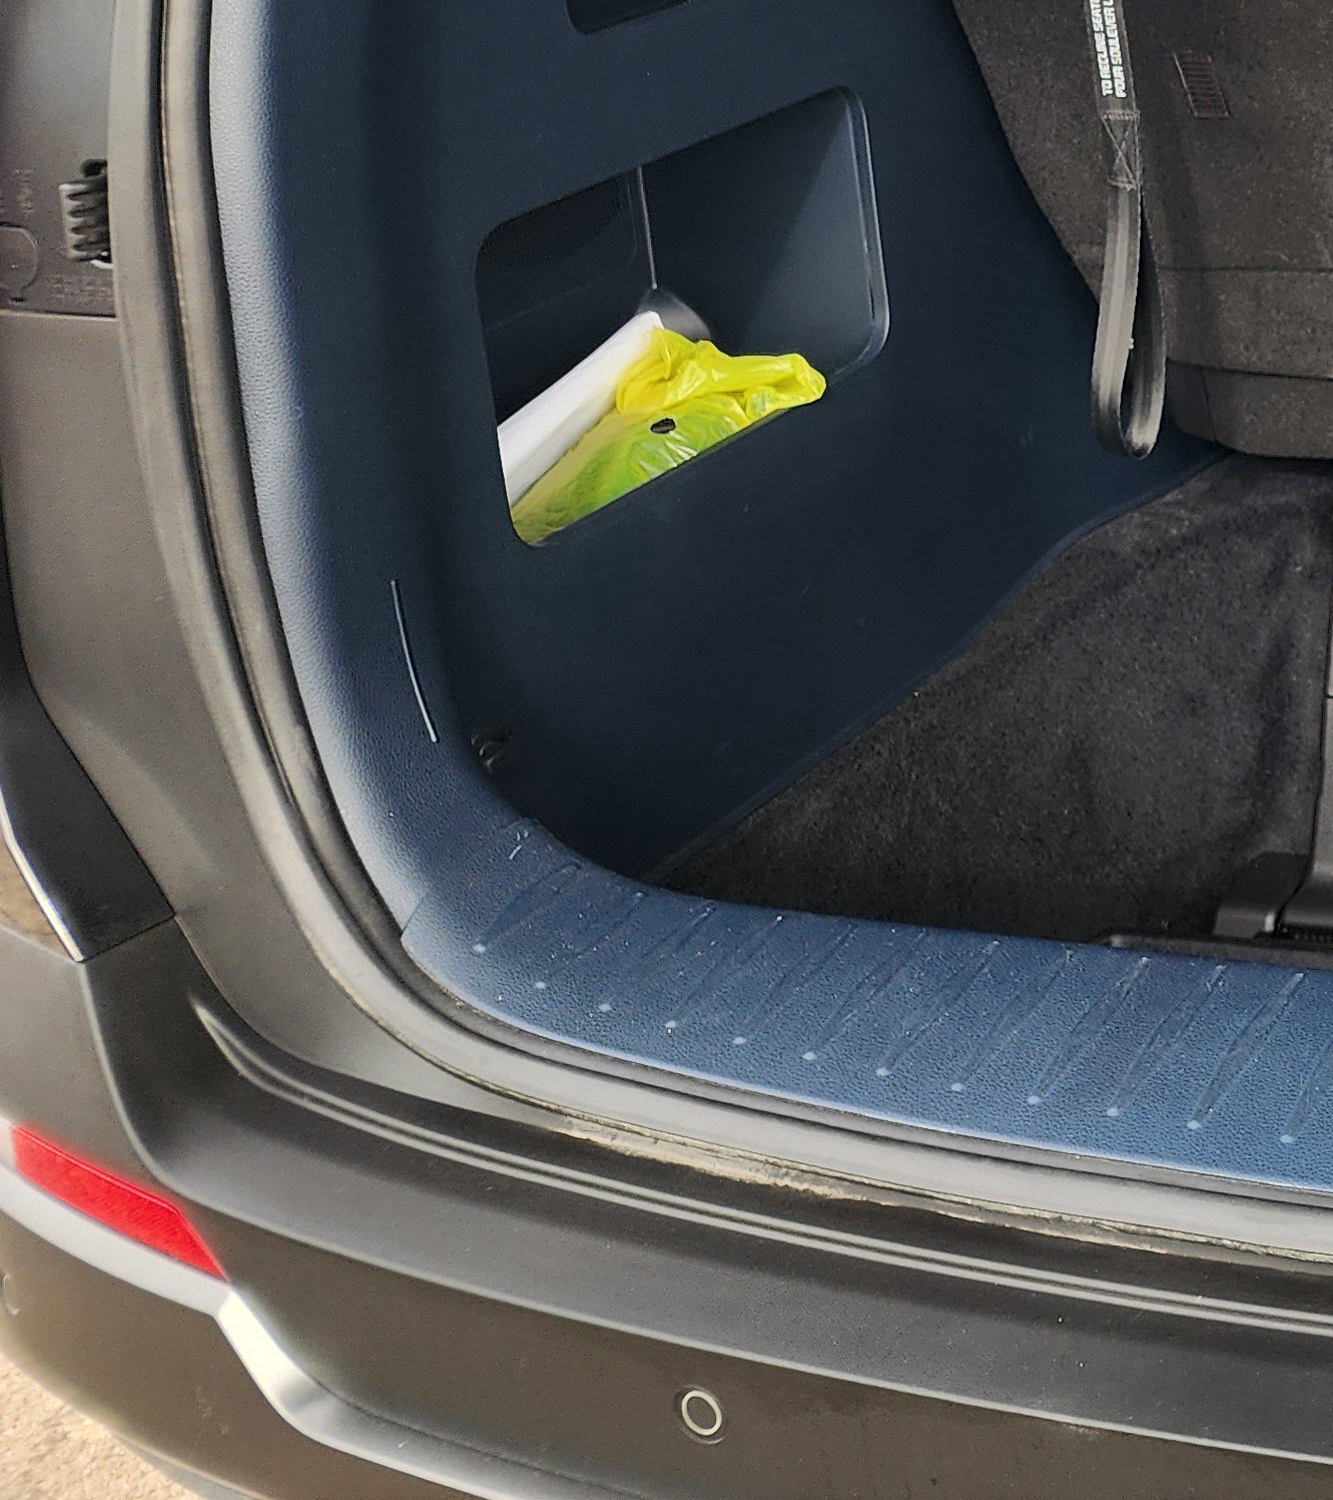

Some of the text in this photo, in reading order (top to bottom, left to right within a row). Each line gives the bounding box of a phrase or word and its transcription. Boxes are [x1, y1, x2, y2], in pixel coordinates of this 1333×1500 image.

[1094, 32, 1111, 78] RECLINE
[1103, 7, 1122, 65] SOULEVER
[1101, 80, 1113, 96] TO
[1112, 66, 1127, 97] POUR
